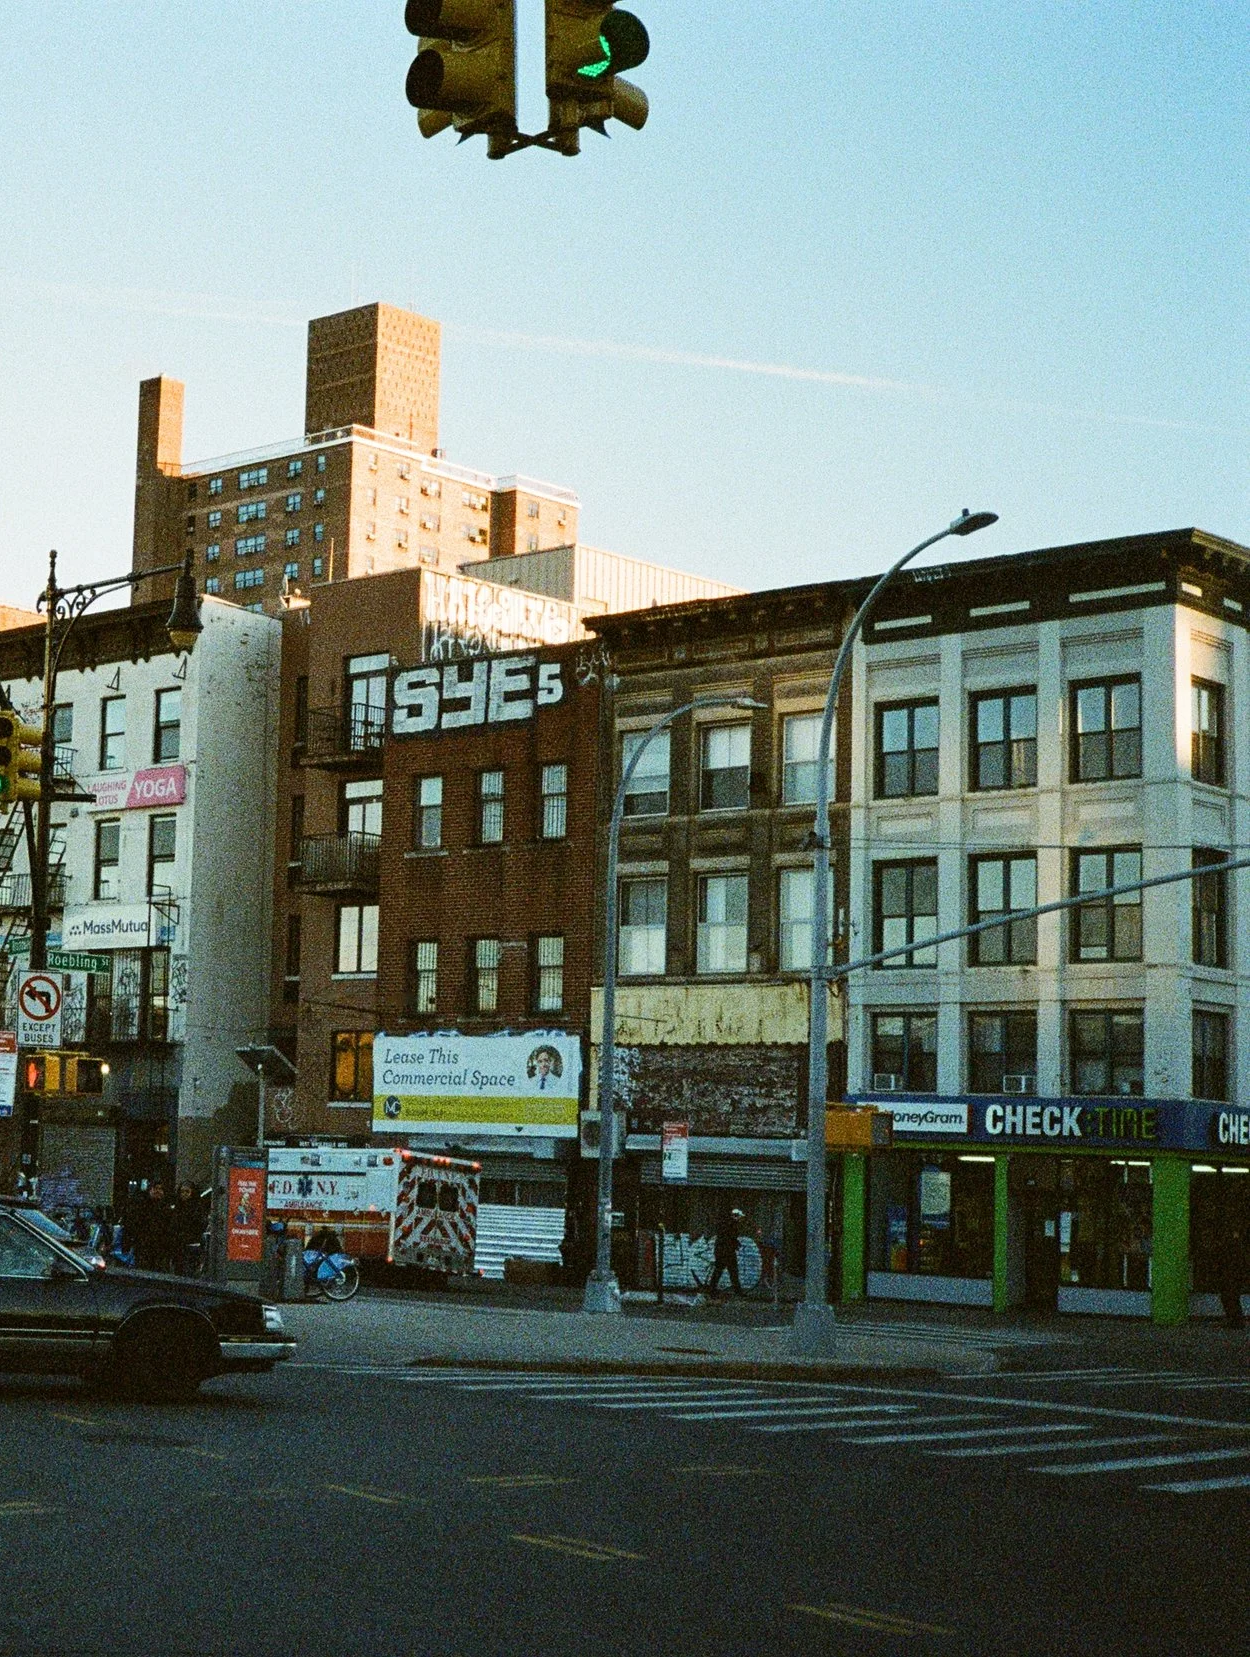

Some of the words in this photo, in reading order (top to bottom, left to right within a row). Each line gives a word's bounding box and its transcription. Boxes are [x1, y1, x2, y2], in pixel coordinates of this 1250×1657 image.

[87, 780, 127, 793] LAUGHING
[134, 777, 178, 800] YOGA
[83, 918, 150, 935] MassMutua
[47, 953, 98, 971] Roebling
[23, 1022, 56, 1032] EXCEPT
[24, 1033, 54, 1043] BUSES
[385, 1048, 424, 1064] Lease
[430, 1048, 459, 1064] This
[383, 1069, 467, 1086] Commercial
[471, 1070, 515, 1089] Space
[890, 1110, 964, 1126] oneyGram.
[985, 1103, 1083, 1137] CHECK
